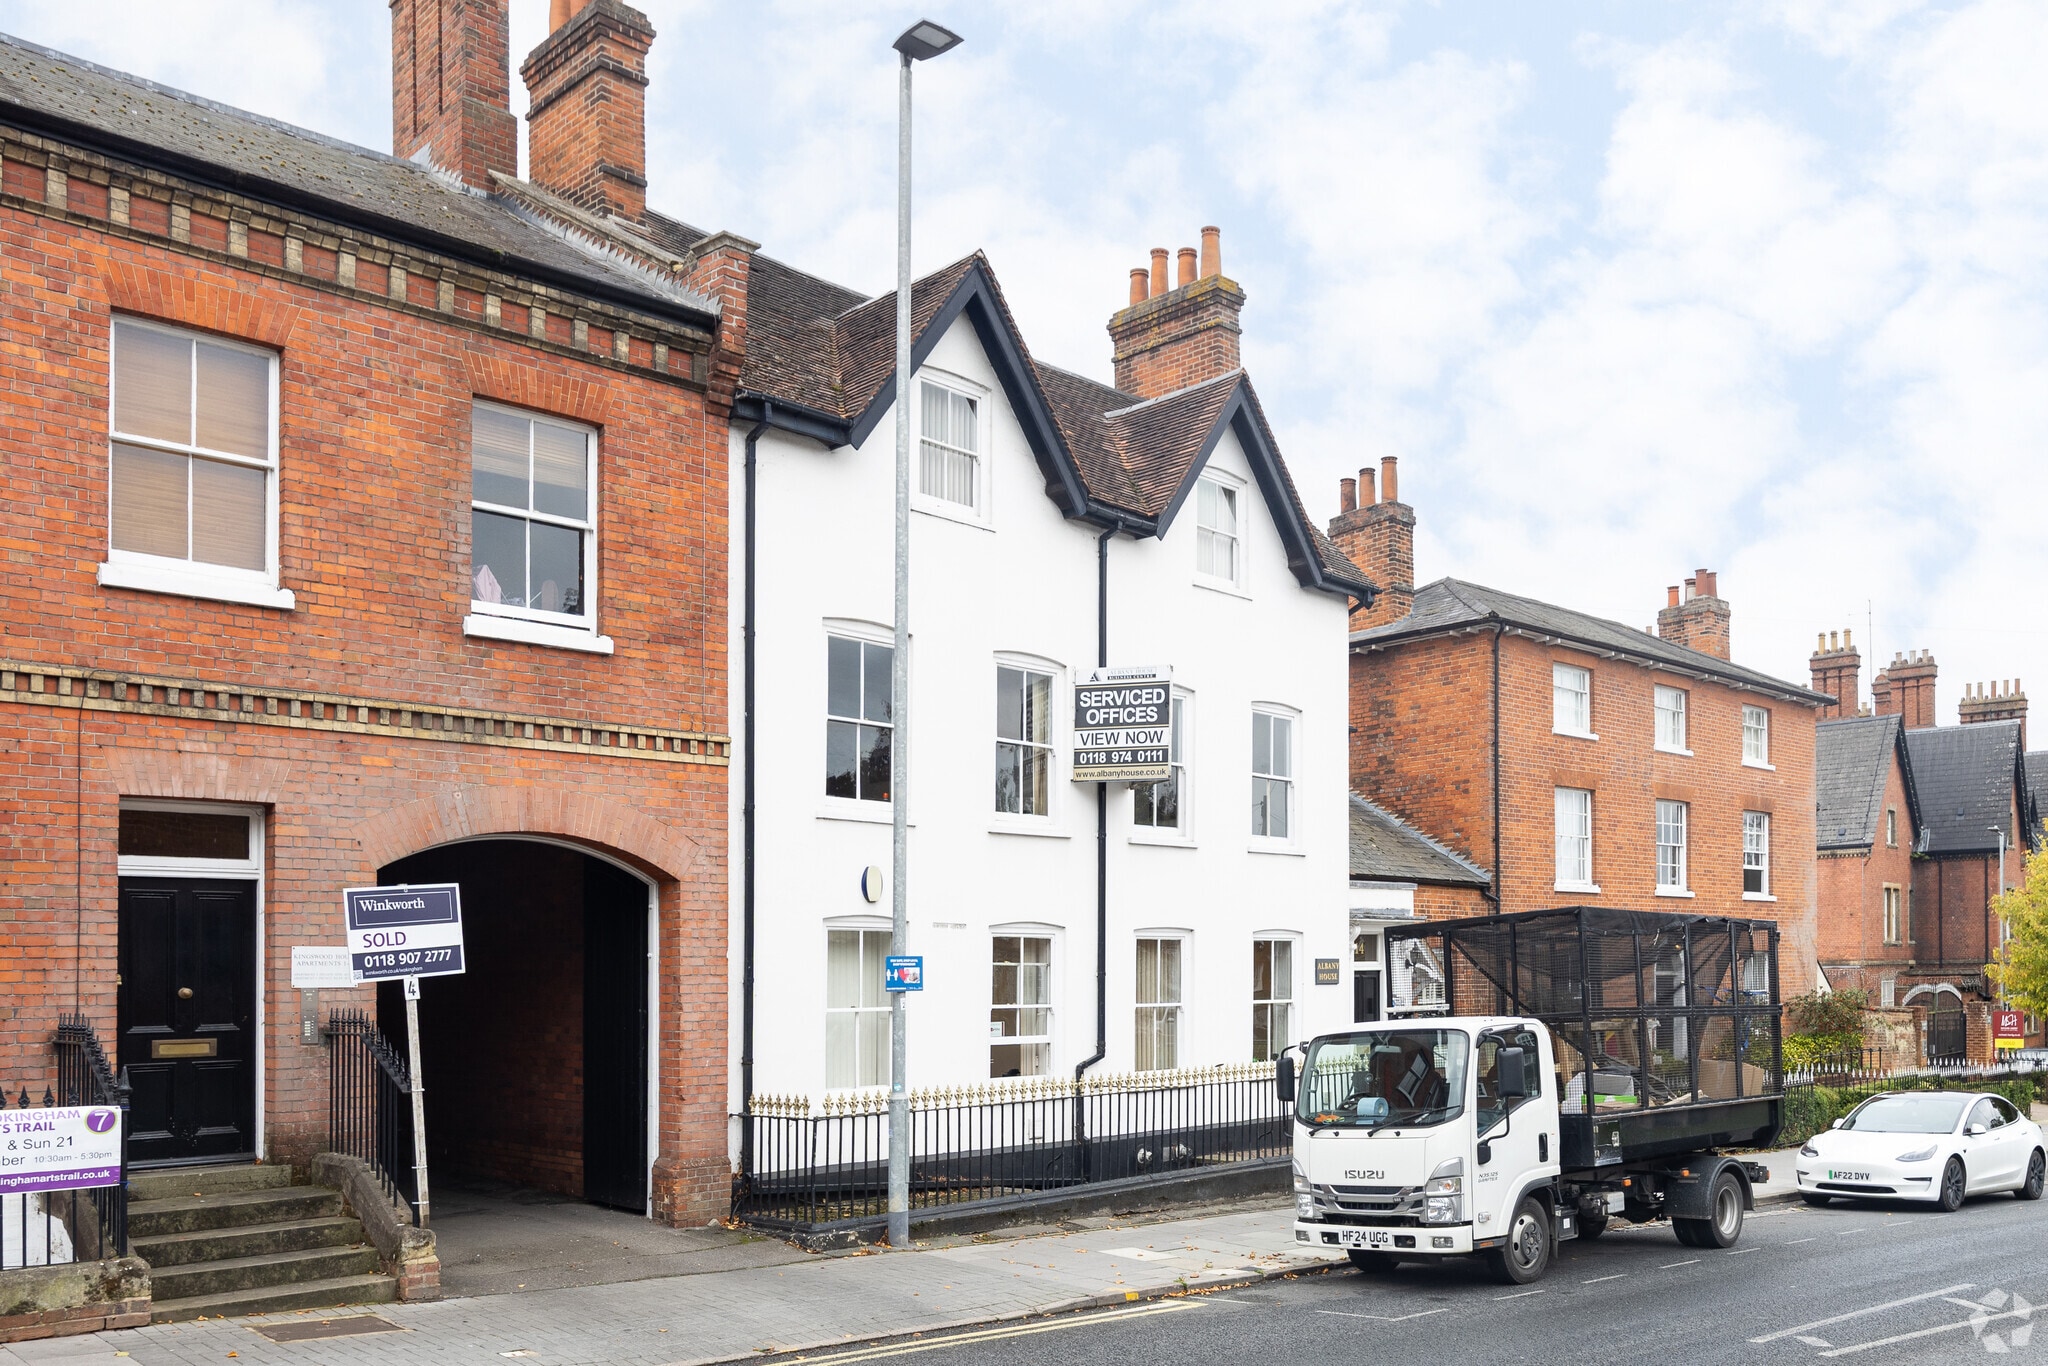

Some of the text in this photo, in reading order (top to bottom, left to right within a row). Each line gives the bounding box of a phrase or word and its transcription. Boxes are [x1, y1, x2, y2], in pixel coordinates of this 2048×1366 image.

[1080, 688, 1166, 707] SERVICED
[1086, 706, 1158, 725] OFFICES
[1080, 730, 1164, 746] VIEW NOW
[1080, 750, 1163, 764] 0118 974 0111
[1075, 768, 1167, 778] www.albanyhouse.co.uk
[359, 897, 426, 912] Winkworth
[363, 931, 407, 949] SOLD
[364, 949, 452, 968] 0118 907 2777
[365, 966, 424, 976] winkworth.co.uk/wokingham
[1317, 962, 1339, 970] ALBANY
[1319, 972, 1338, 980] HOUSE
[408, 980, 417, 996] 4
[0, 1110, 81, 1123] KINGHAM
[94, 1112, 110, 1131] 7
[15, 1121, 56, 1133] TRAIL
[8, 1136, 73, 1151] & Sun 21
[34, 1154, 72, 1164] 10:30am
[80, 1151, 112, 1161] 5:30pm
[1344, 1169, 1385, 1180] ISUZU
[1833, 1171, 1870, 1180] AF22 DVV
[1342, 1230, 1389, 1243] HF24 UGG
